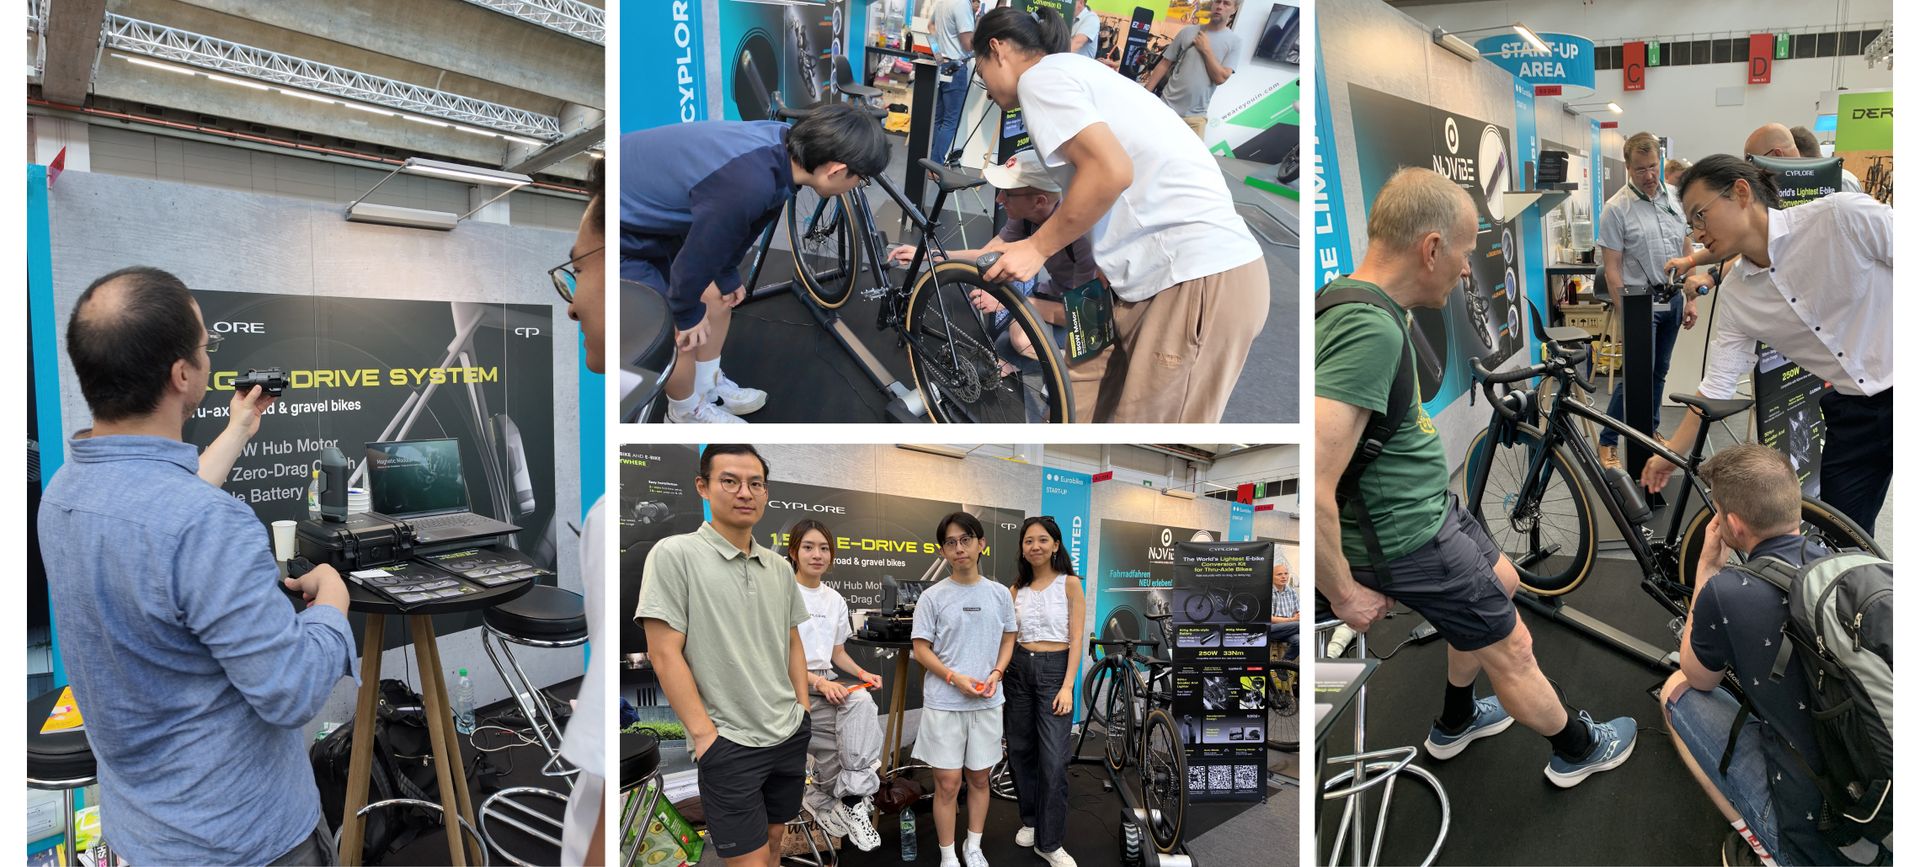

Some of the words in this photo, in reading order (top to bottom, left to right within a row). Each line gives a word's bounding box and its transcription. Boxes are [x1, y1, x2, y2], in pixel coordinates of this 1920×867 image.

[672, 0, 696, 123] CYPLOR
[1519, 61, 1566, 78] AREA
[1752, 57, 1768, 77] D
[1627, 63, 1641, 83] C
[1221, 82, 1280, 120] weareyouin.com
[1852, 107, 1893, 119] DER
[1778, 188, 1796, 197] orld's
[1796, 187, 1819, 197] Lightest
[287, 369, 381, 389] DRIVE
[389, 366, 498, 386] SYSTEM
[1782, 366, 1800, 381] 250W
[278, 401, 288, 415] &
[290, 399, 329, 417] gravel
[331, 399, 362, 412] bikes
[263, 440, 293, 456] Hub
[232, 463, 308, 482] Zero-Drag
[1060, 475, 1084, 486] Eurobike
[250, 486, 304, 504] Battery
[1046, 486, 1068, 495] START-UP
[768, 500, 847, 515] CYPLORE
[770, 533, 790, 546] 1.5
[837, 536, 918, 554] E-DRIVE
[834, 557, 851, 566] road
[853, 557, 860, 566] &
[861, 558, 885, 567] gravel
[887, 558, 906, 567] bikes
[1109, 569, 1151, 578] Fahrradfahren
[843, 581, 863, 590] Hub
[865, 581, 882, 590] Mot
[1138, 579, 1151, 587] NEU
[1151, 579, 1173, 587] erleben!
[844, 595, 872, 605] o-Drag
[1727, 671, 1742, 687] Mot
